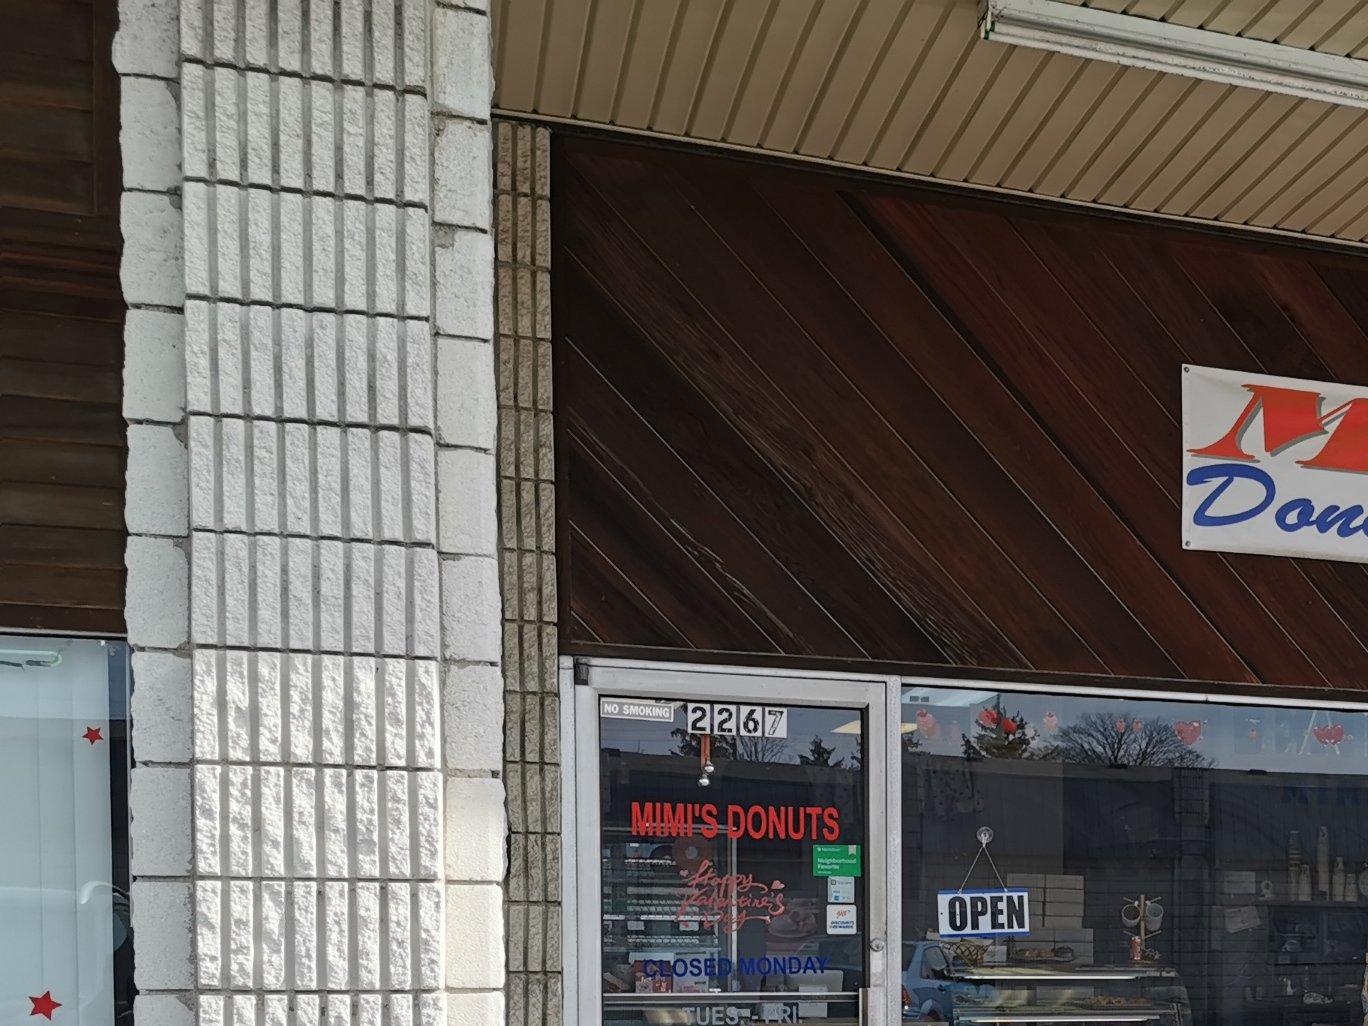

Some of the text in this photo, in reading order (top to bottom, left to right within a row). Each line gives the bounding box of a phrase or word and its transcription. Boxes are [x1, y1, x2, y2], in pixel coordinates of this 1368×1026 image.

[604, 703, 671, 718] NO SMOKING
[690, 706, 785, 736] 2267
[631, 801, 840, 841] MIMI'S DONUTS
[948, 894, 1026, 932] OPEN
[643, 956, 829, 978] CLOSED MONDAY
